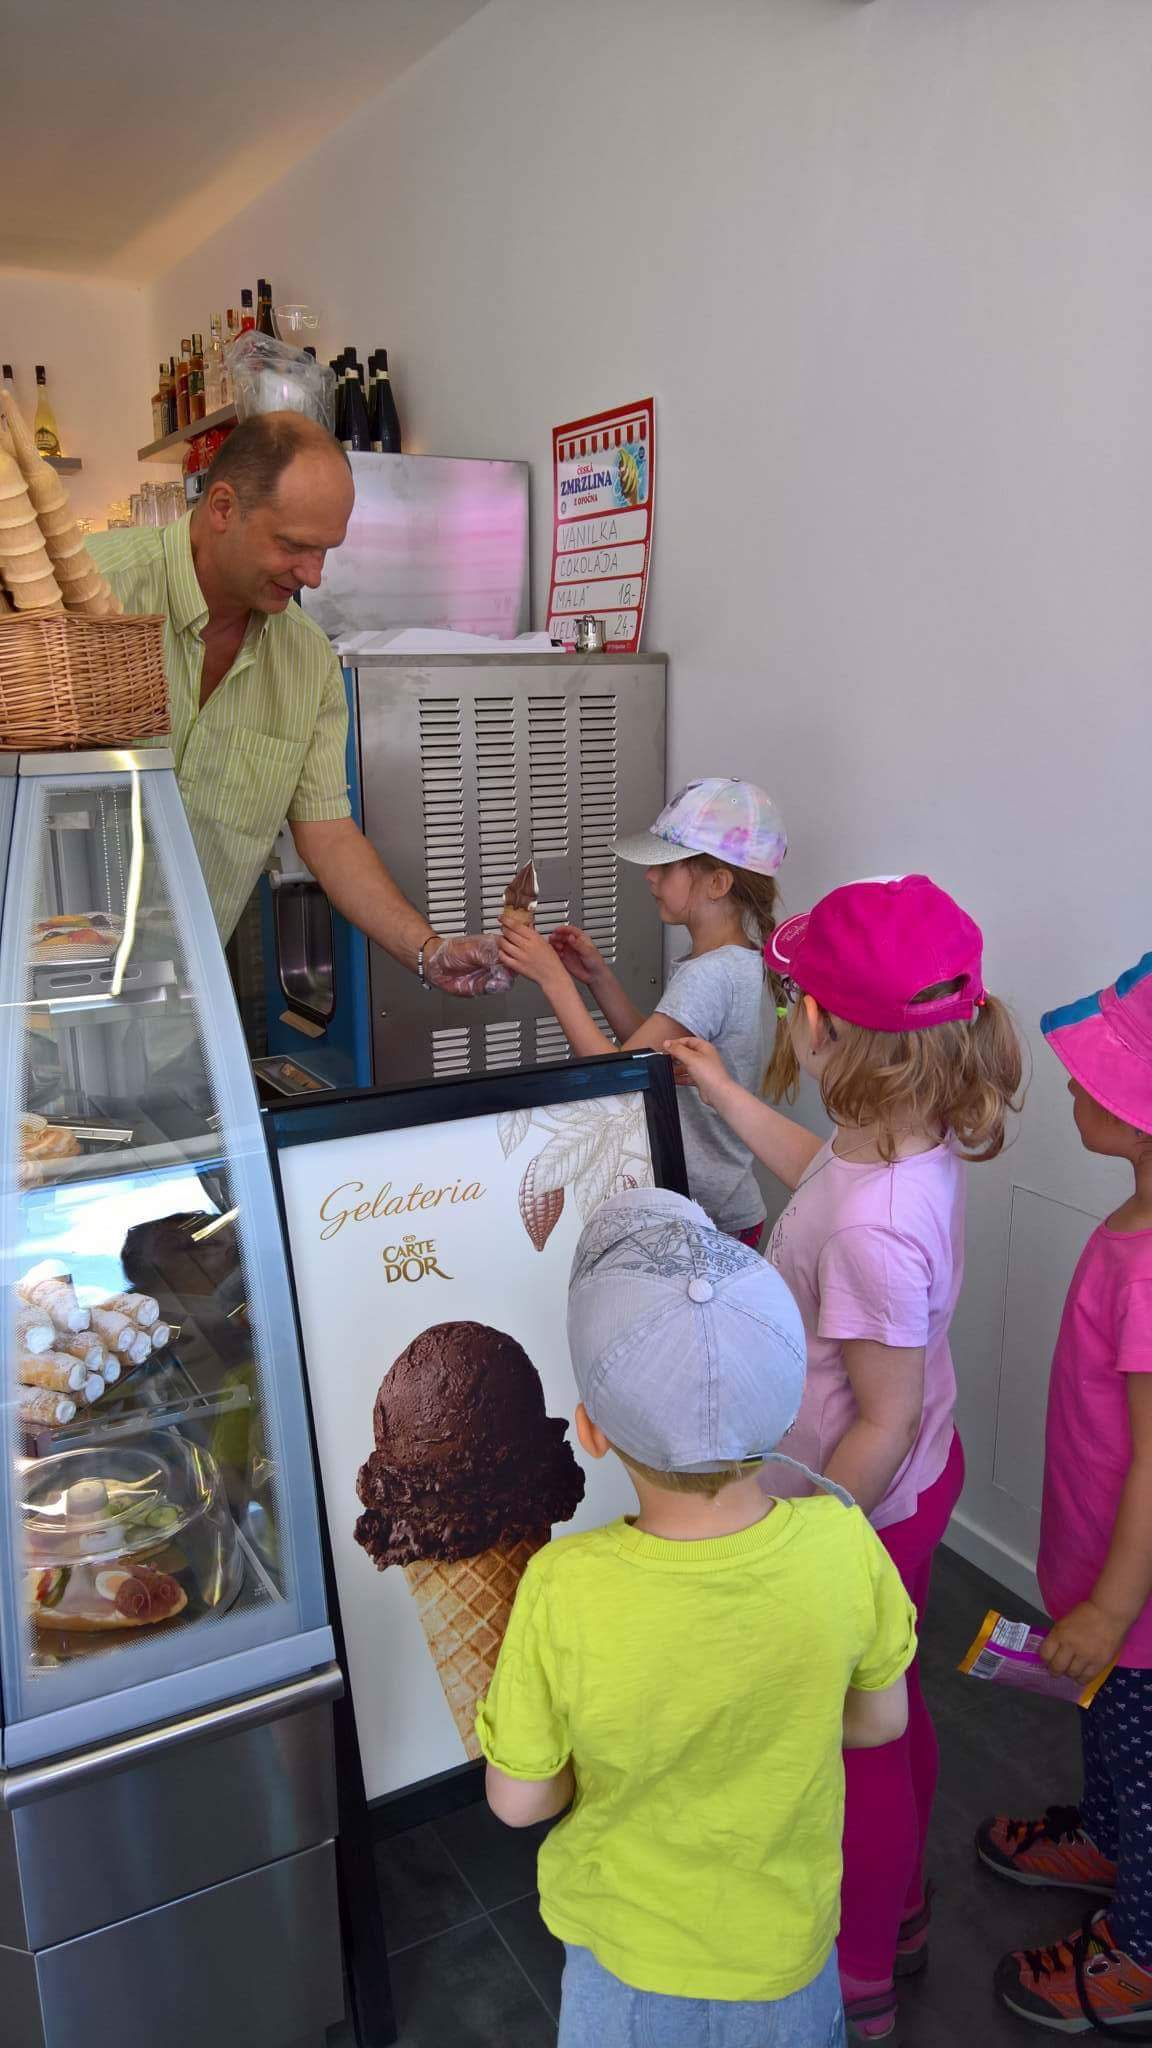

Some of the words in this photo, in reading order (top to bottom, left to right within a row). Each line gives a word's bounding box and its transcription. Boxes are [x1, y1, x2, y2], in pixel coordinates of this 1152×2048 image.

[560, 470, 613, 497] ZMRZLINA
[562, 519, 618, 550] VANILKA
[552, 619, 577, 640] VELK
[319, 1178, 487, 1241] Gelateria
[382, 1239, 436, 1264] CARTE
[385, 1257, 454, 1284] D'OR
